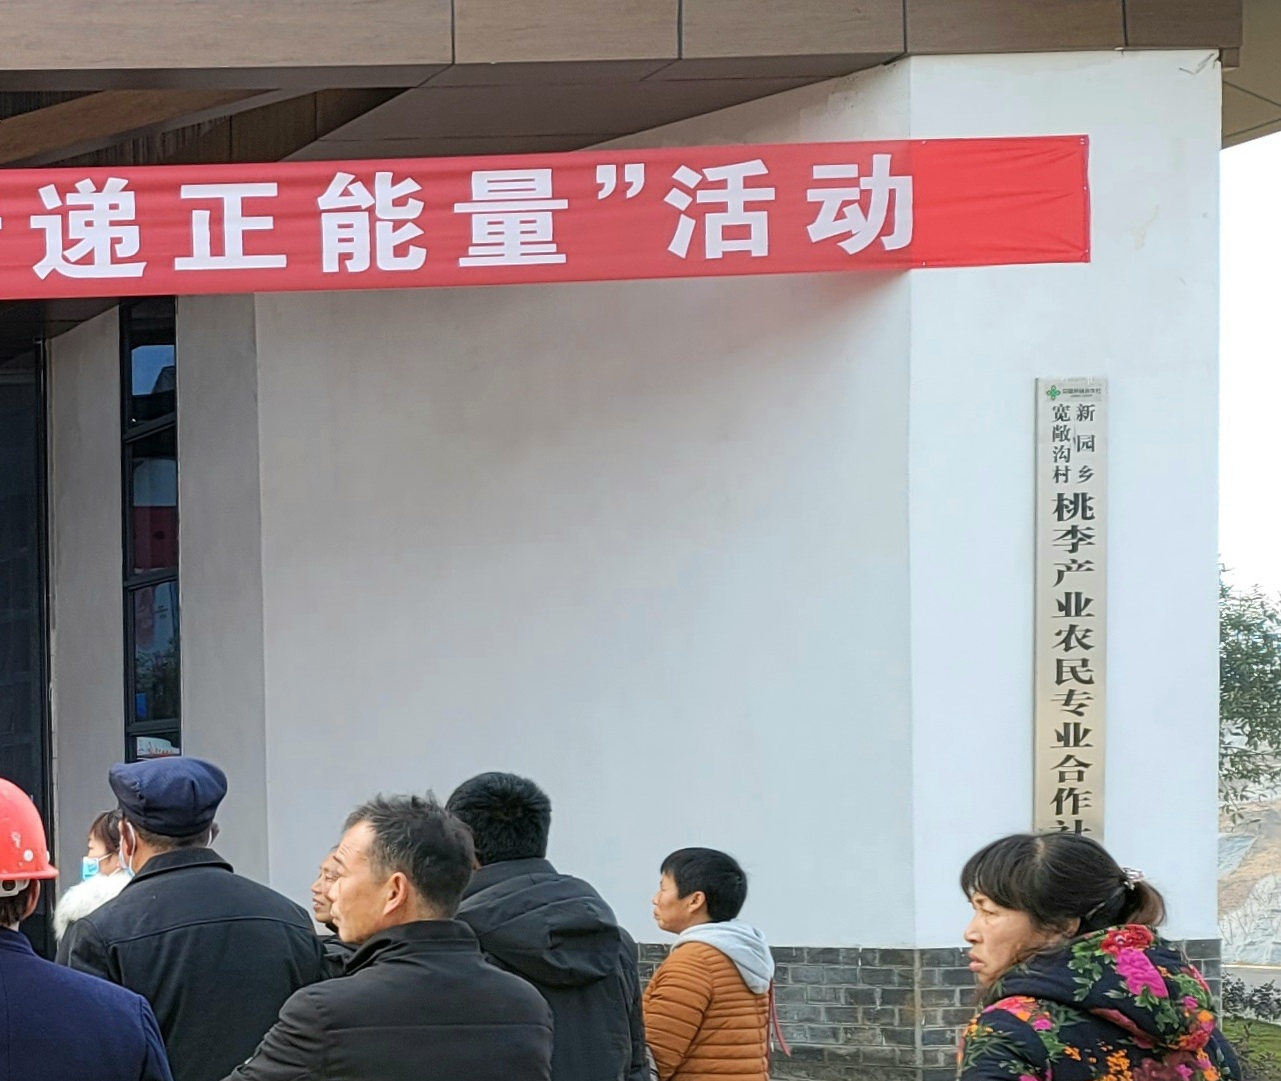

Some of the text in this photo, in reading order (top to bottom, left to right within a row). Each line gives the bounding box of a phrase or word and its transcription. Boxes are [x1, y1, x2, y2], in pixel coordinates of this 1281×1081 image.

[1051, 403, 1072, 484] 宽敞沟村
[1076, 403, 1096, 484] 新园乡
